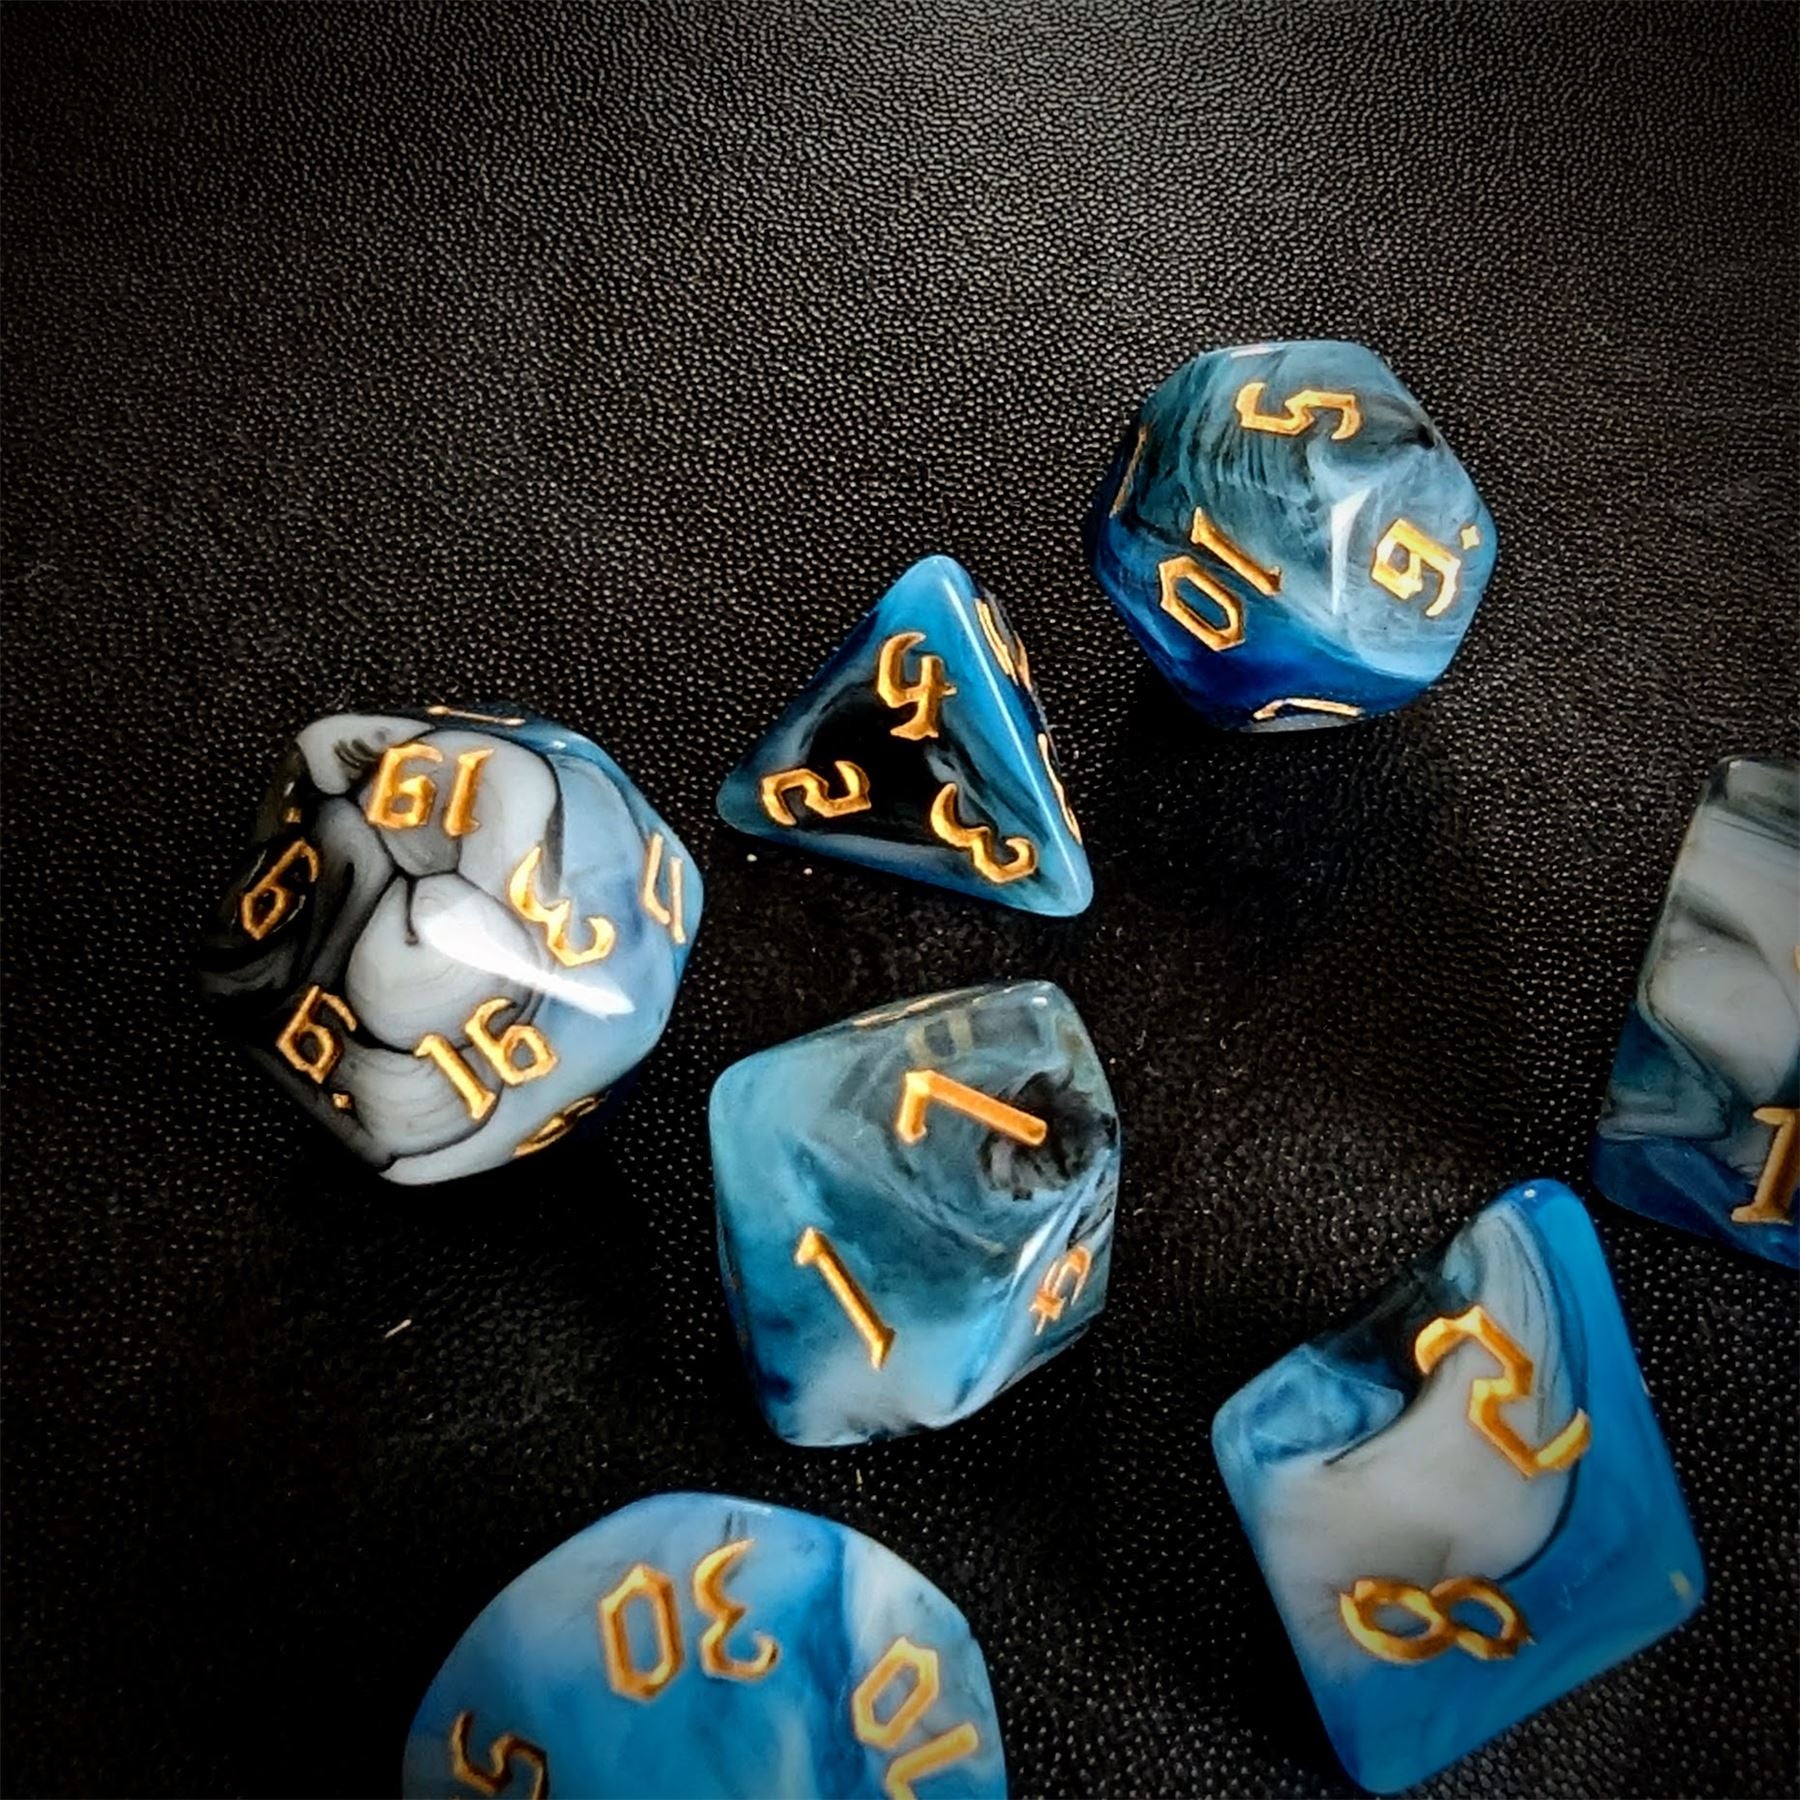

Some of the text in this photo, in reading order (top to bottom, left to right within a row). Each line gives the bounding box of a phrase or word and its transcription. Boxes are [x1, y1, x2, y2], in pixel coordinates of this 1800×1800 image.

[1235, 382, 1363, 440] 5
[1158, 506, 1282, 652] 10
[876, 631, 958, 741] 4
[367, 742, 495, 839] 19
[759, 759, 872, 827] 2
[930, 782, 1038, 884] 3
[507, 844, 616, 968] 3
[412, 998, 559, 1123] 16
[896, 1067, 1049, 1146] 7
[795, 1226, 896, 1371] 1
[1414, 1304, 1592, 1479] 2
[599, 1537, 778, 1704] 30
[1339, 1576, 1532, 1664] 8
